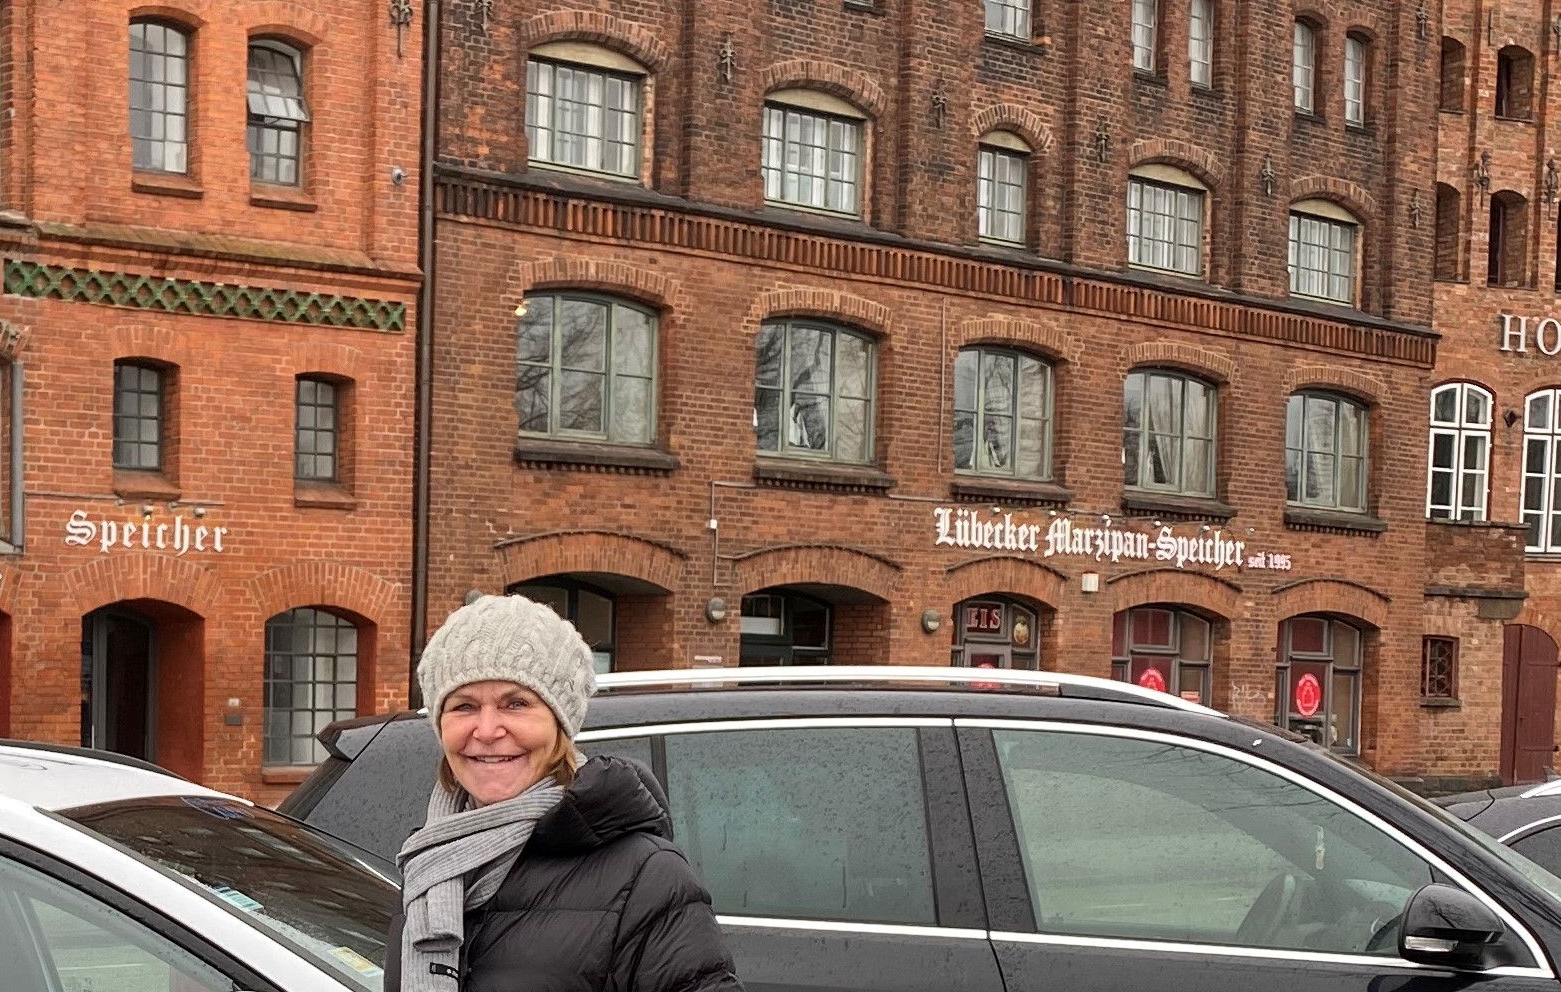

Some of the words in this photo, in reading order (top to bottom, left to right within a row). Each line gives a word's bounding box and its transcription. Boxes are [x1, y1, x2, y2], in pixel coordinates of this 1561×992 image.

[65, 509, 228, 557] Speicher
[934, 507, 1040, 551] Lübecker
[1044, 518, 1245, 570] Marzipan-Speicher
[1267, 553, 1291, 570] 1995
[966, 607, 1001, 630] EIS
